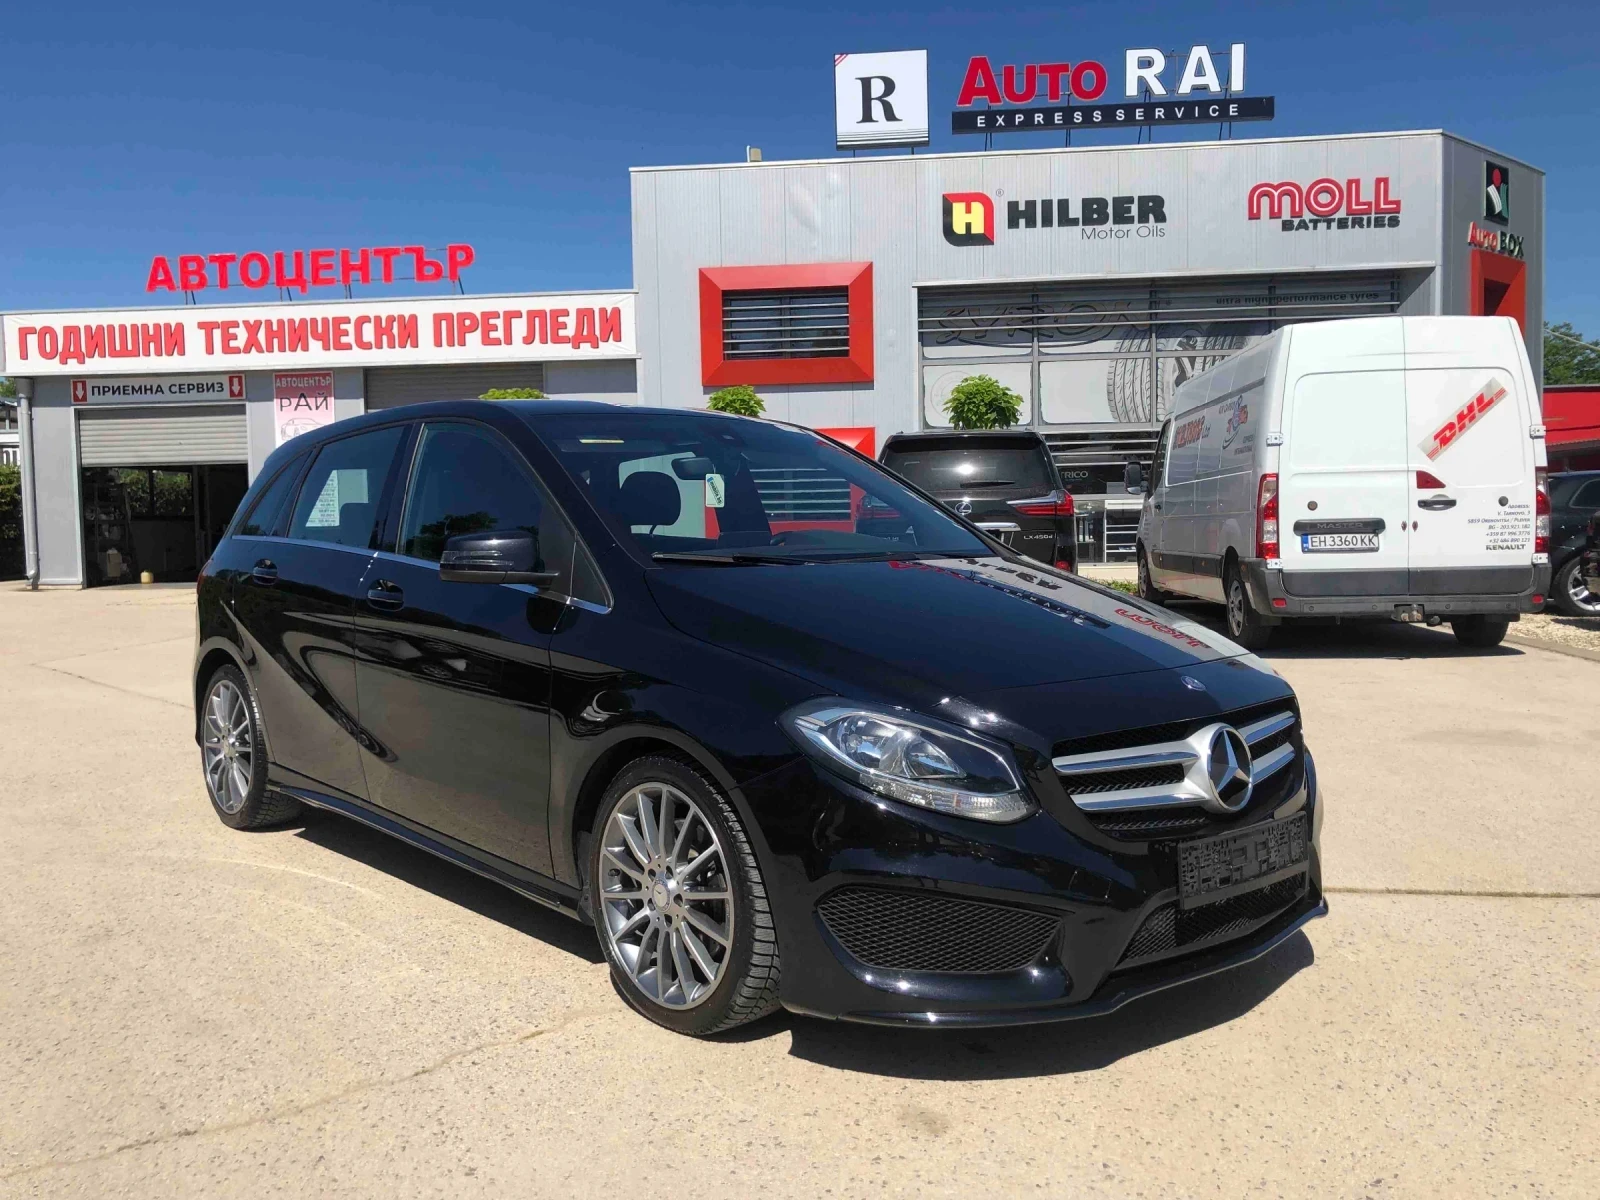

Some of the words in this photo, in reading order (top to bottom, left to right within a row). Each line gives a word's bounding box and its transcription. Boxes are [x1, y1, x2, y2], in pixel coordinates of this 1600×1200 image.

[1124, 42, 1247, 98] RAI
[855, 76, 903, 124] R
[976, 110, 1103, 127] EXPRESS
[1115, 103, 1240, 122] SERVICE
[1007, 194, 1167, 230] HILBER
[1281, 215, 1401, 232] BATTERIES
[1081, 227, 1132, 240] Motor
[1136, 225, 1166, 238] Oils
[146, 244, 475, 293] АВТОЦЕНТЪР
[18, 322, 186, 365] ГОДИШНИ
[197, 314, 418, 355] ТЕХНИЧЕСКИ
[433, 307, 622, 349] ПРЕГЛЕДИ
[91, 384, 164, 397] ПРИЕМНА
[168, 381, 225, 395] СЕРВИЗ
[275, 375, 332, 388] АВТОЦЕНТЪР
[279, 392, 329, 411] РАЙ
[1433, 392, 1495, 450] DHL
